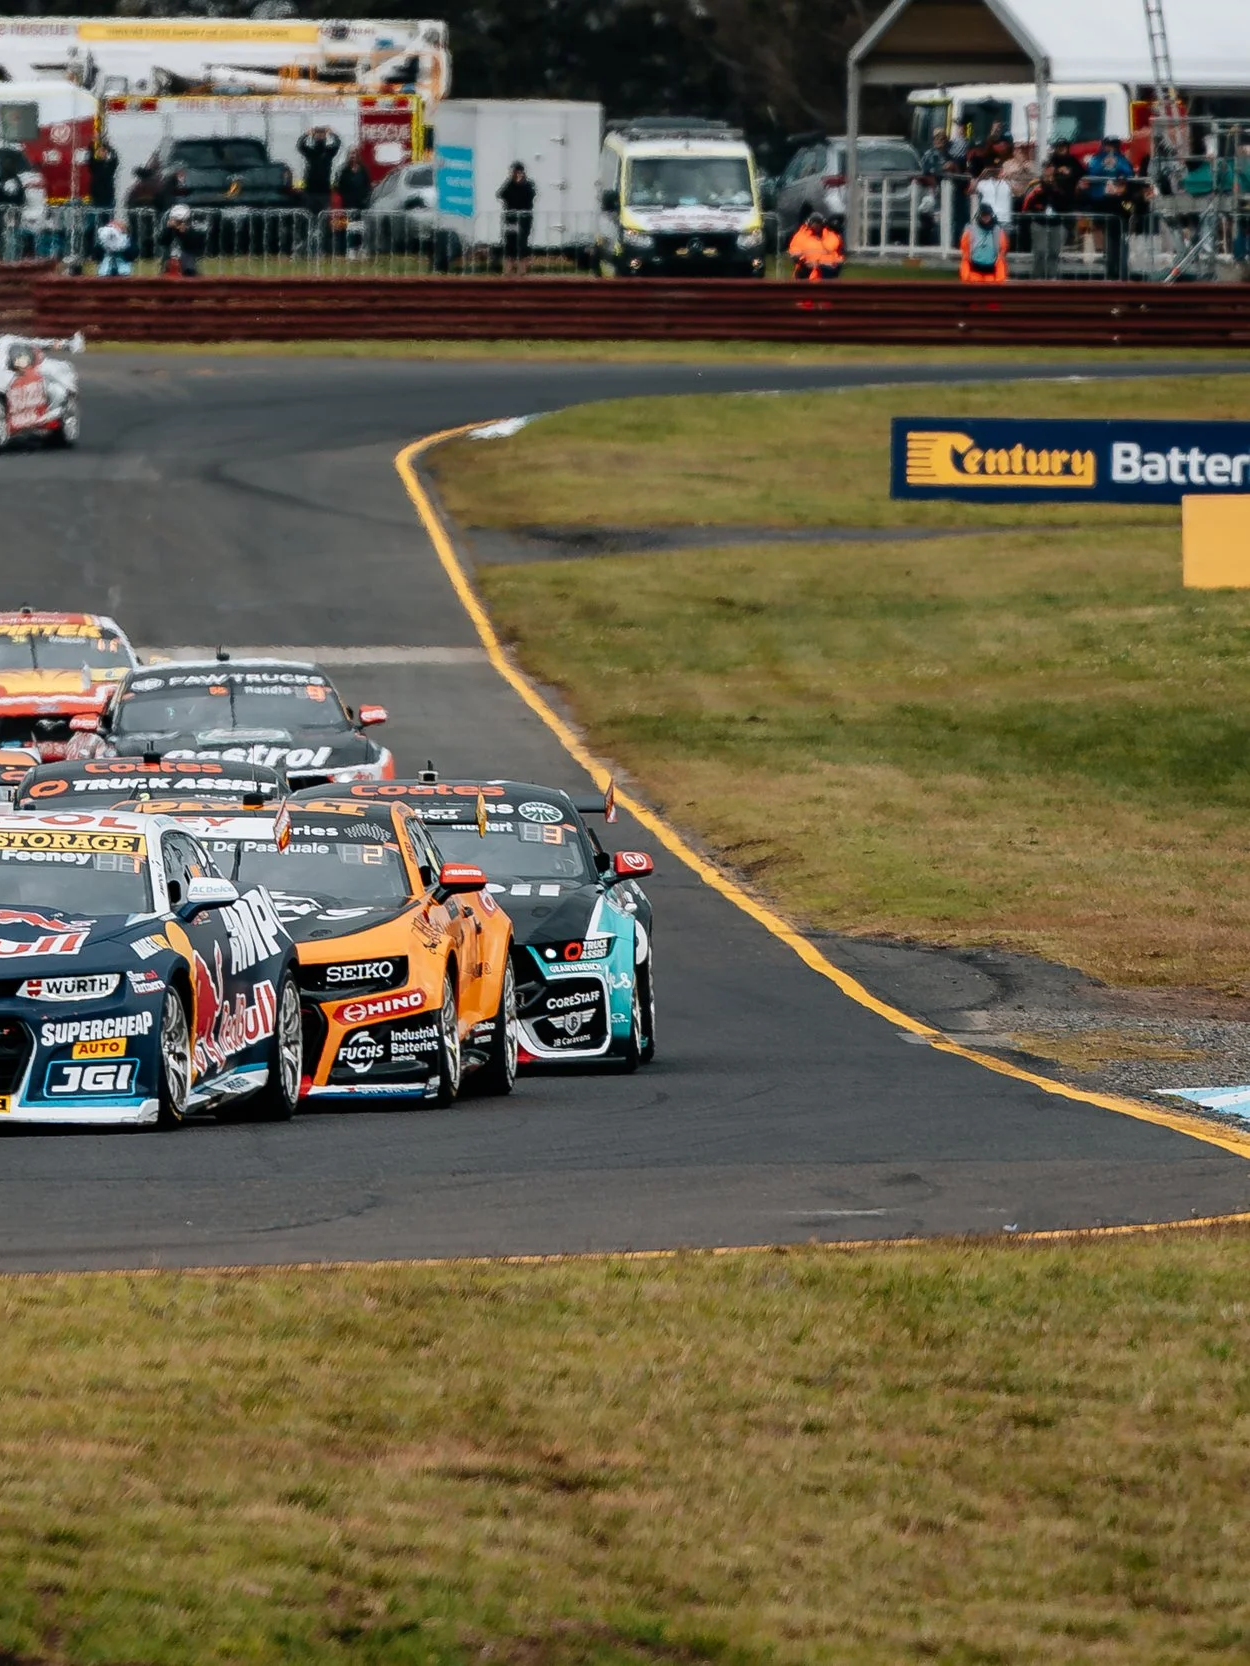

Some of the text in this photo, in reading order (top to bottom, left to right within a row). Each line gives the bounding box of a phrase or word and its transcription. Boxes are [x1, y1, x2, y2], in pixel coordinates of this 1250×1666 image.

[906, 431, 1097, 488] Century
[229, 673, 324, 685] TRUCKS
[72, 778, 278, 792] TRUCK ASSIST
[213, 842, 236, 852] De
[1, 850, 91, 865] Feeney
[583, 939, 608, 950] TRUCK
[580, 950, 607, 959] ASSIST
[326, 961, 394, 983] SEIKO
[46, 978, 109, 994] WÜRTH
[367, 992, 423, 1015] HINO
[41, 1011, 153, 1047] SUPERCHEAP
[390, 1025, 440, 1041] Industrial
[390, 1039, 439, 1054] Batteries
[562, 1034, 591, 1045] Caravans
[78, 1041, 120, 1055] AUTO
[338, 1044, 385, 1061] FUCHS
[51, 1065, 132, 1093] JGI
